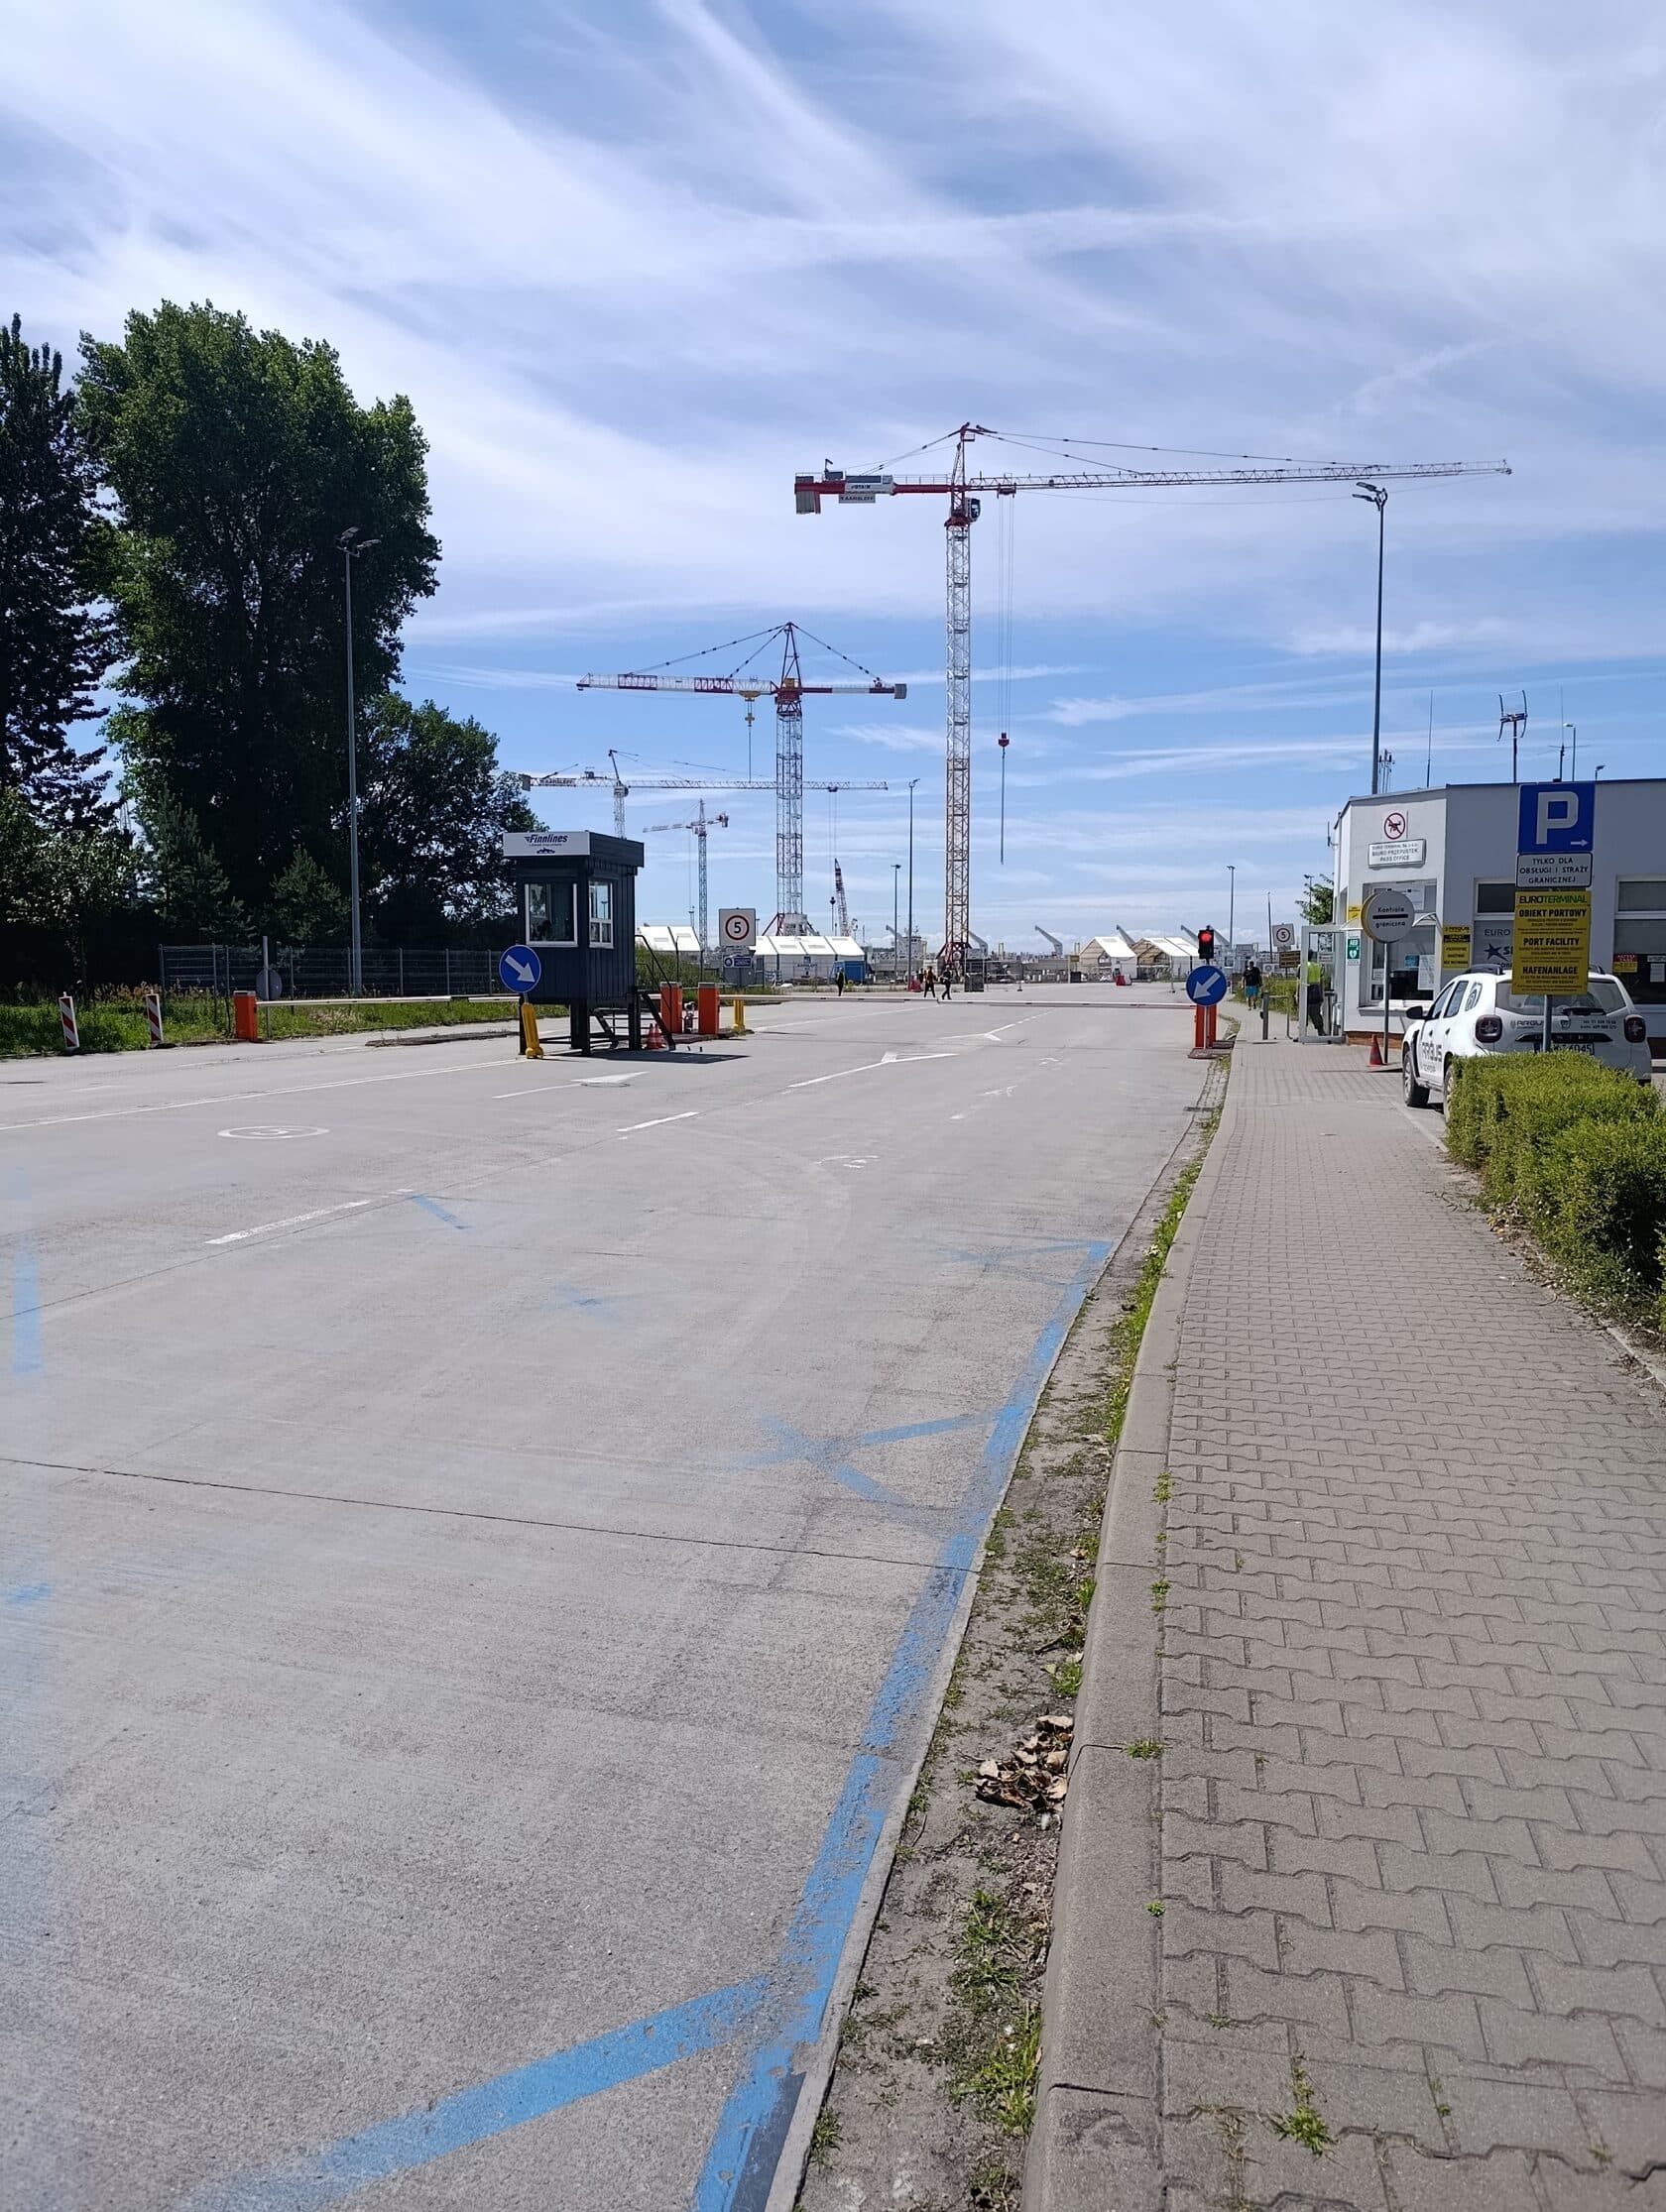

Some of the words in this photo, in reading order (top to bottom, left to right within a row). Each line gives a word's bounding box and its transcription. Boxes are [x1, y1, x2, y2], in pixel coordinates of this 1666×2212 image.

[1536, 791, 1579, 845] P
[530, 834, 568, 843] Finnlines
[1562, 864, 1589, 873] STRAŻY
[1528, 875, 1577, 884] GRANICZNEJ
[1519, 894, 1588, 903] EUROTERMINAL
[1548, 908, 1587, 917] PORTOWY
[734, 921, 742, 934] 5
[1523, 937, 1544, 946] PORT
[1545, 937, 1580, 946] FACILITY
[1522, 966, 1579, 975] HAFENANLAGE
